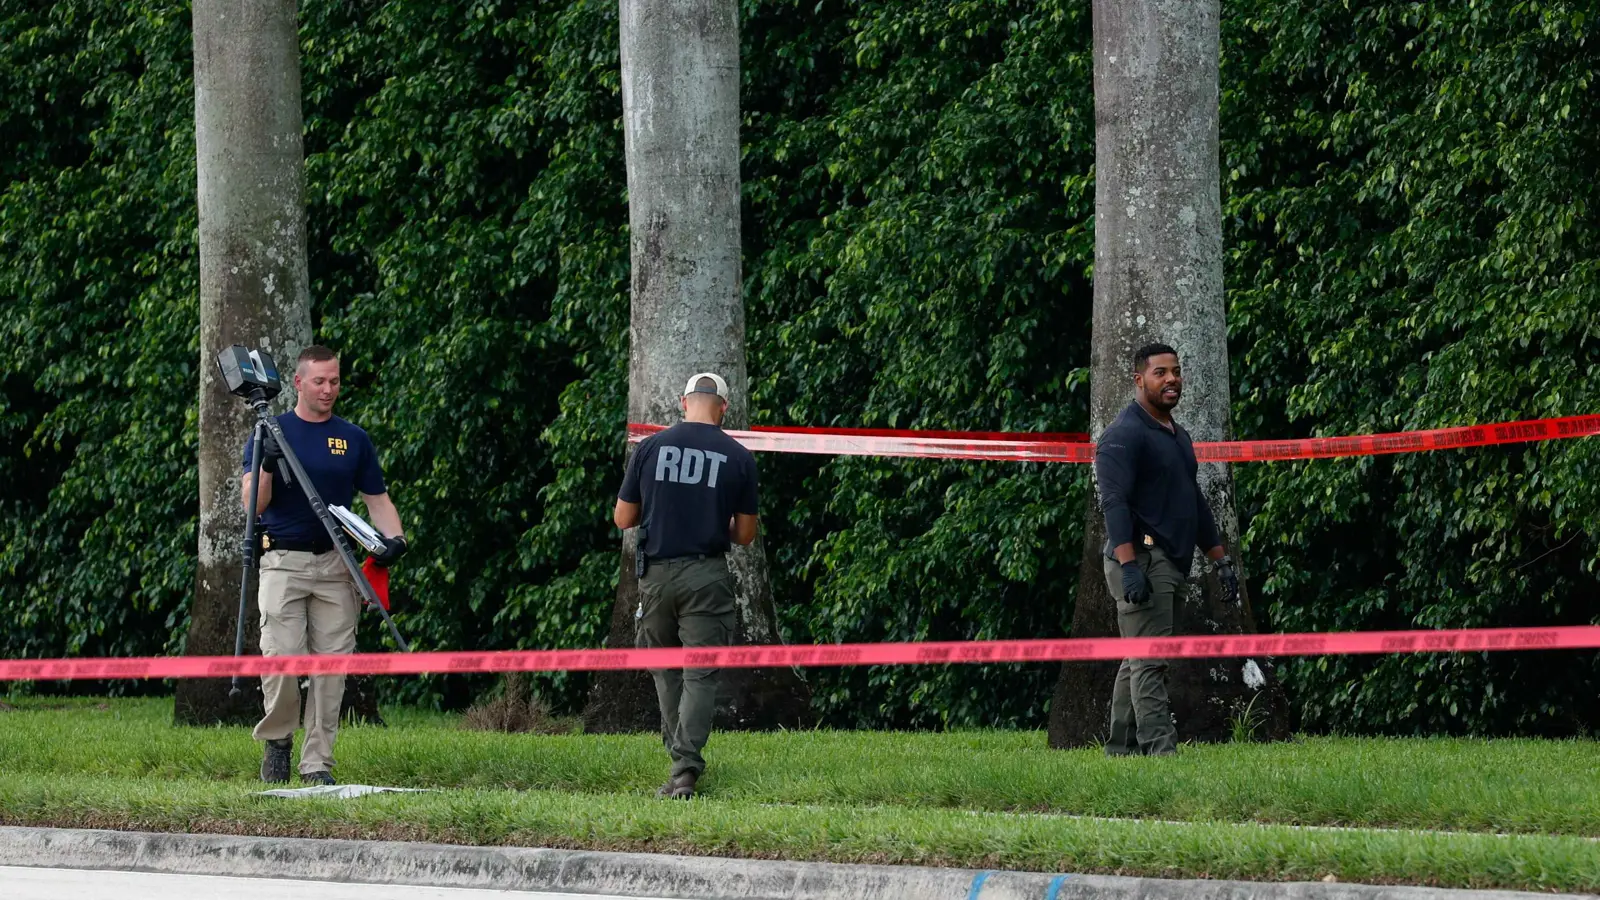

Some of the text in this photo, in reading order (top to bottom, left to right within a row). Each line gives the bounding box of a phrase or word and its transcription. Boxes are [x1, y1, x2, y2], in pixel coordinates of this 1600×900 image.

[327, 437, 348, 449] FBI
[331, 448, 346, 456] ERT
[655, 445, 727, 488] RDT
